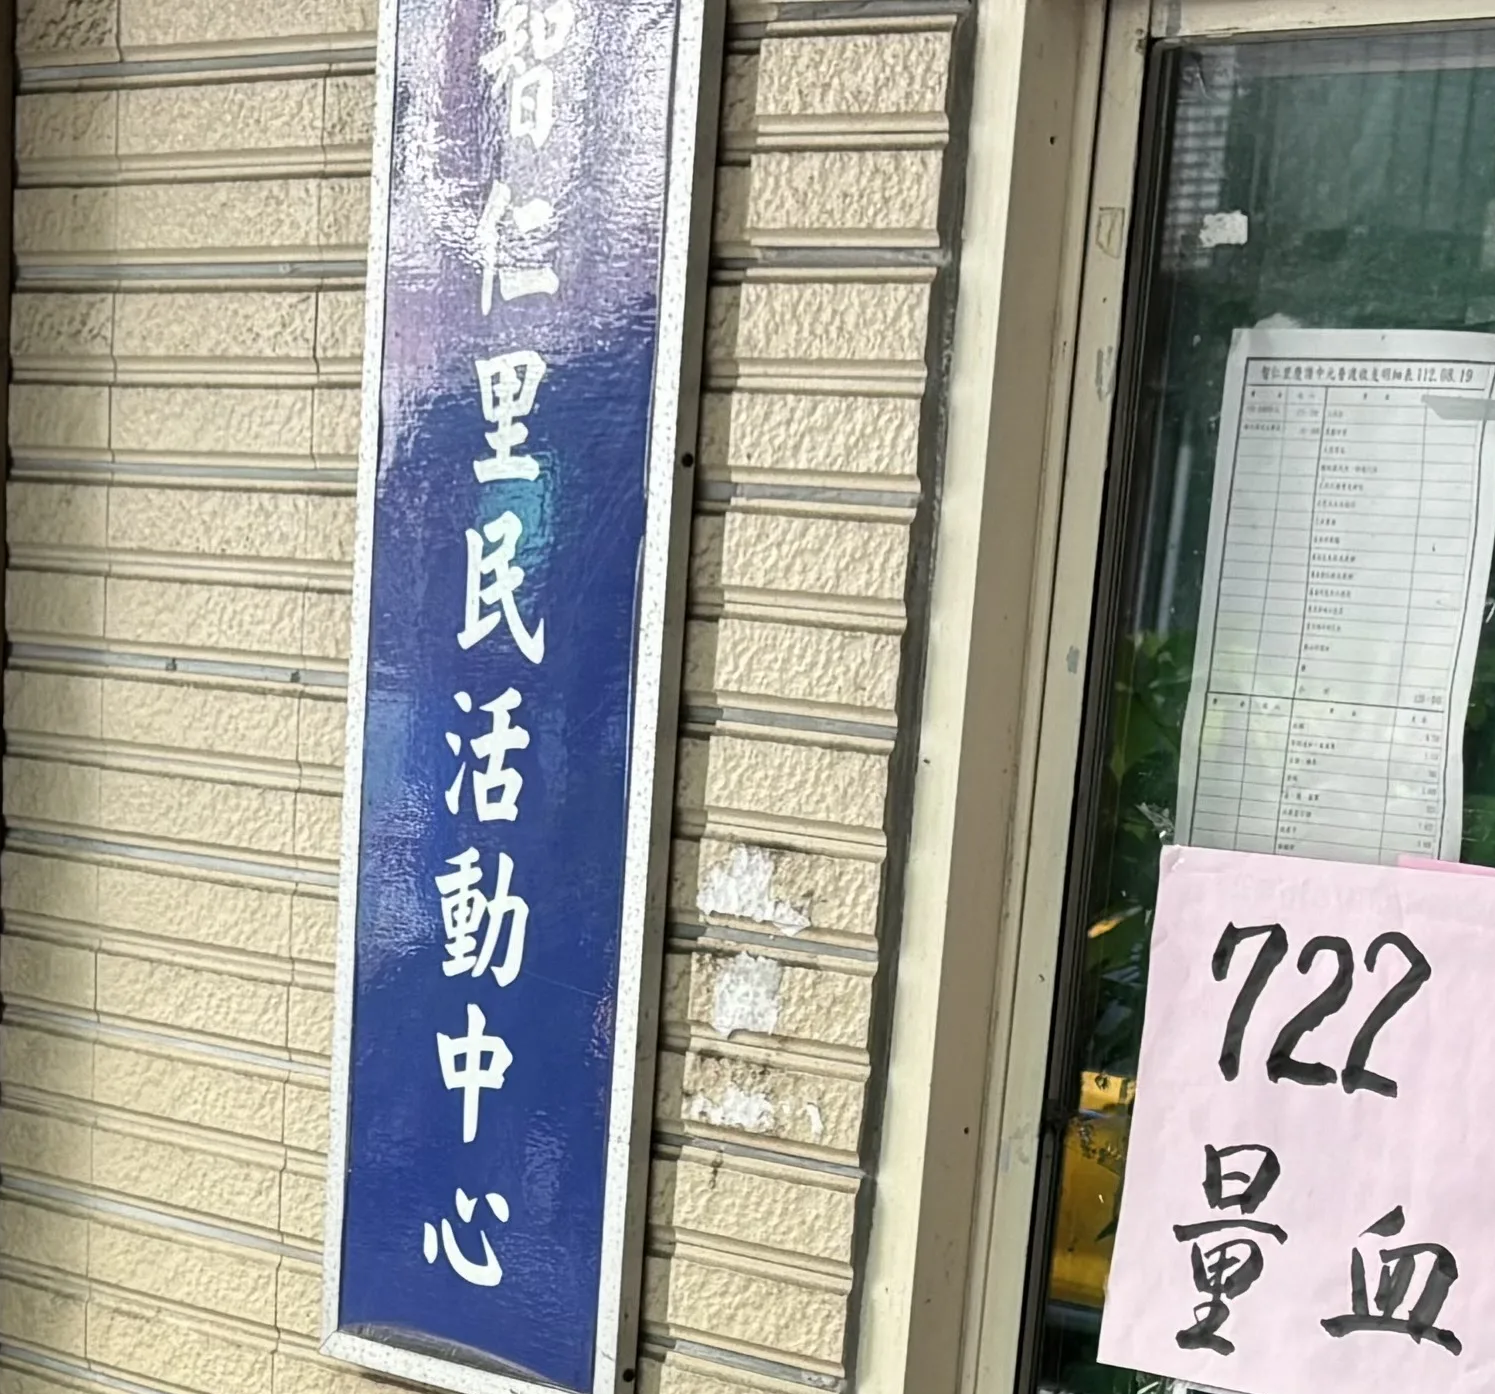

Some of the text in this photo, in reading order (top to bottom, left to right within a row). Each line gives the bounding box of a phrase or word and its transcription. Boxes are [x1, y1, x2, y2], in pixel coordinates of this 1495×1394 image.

[423, 0, 574, 1288] 智仁里民活動中心
[1210, 921, 1432, 1098] 722
